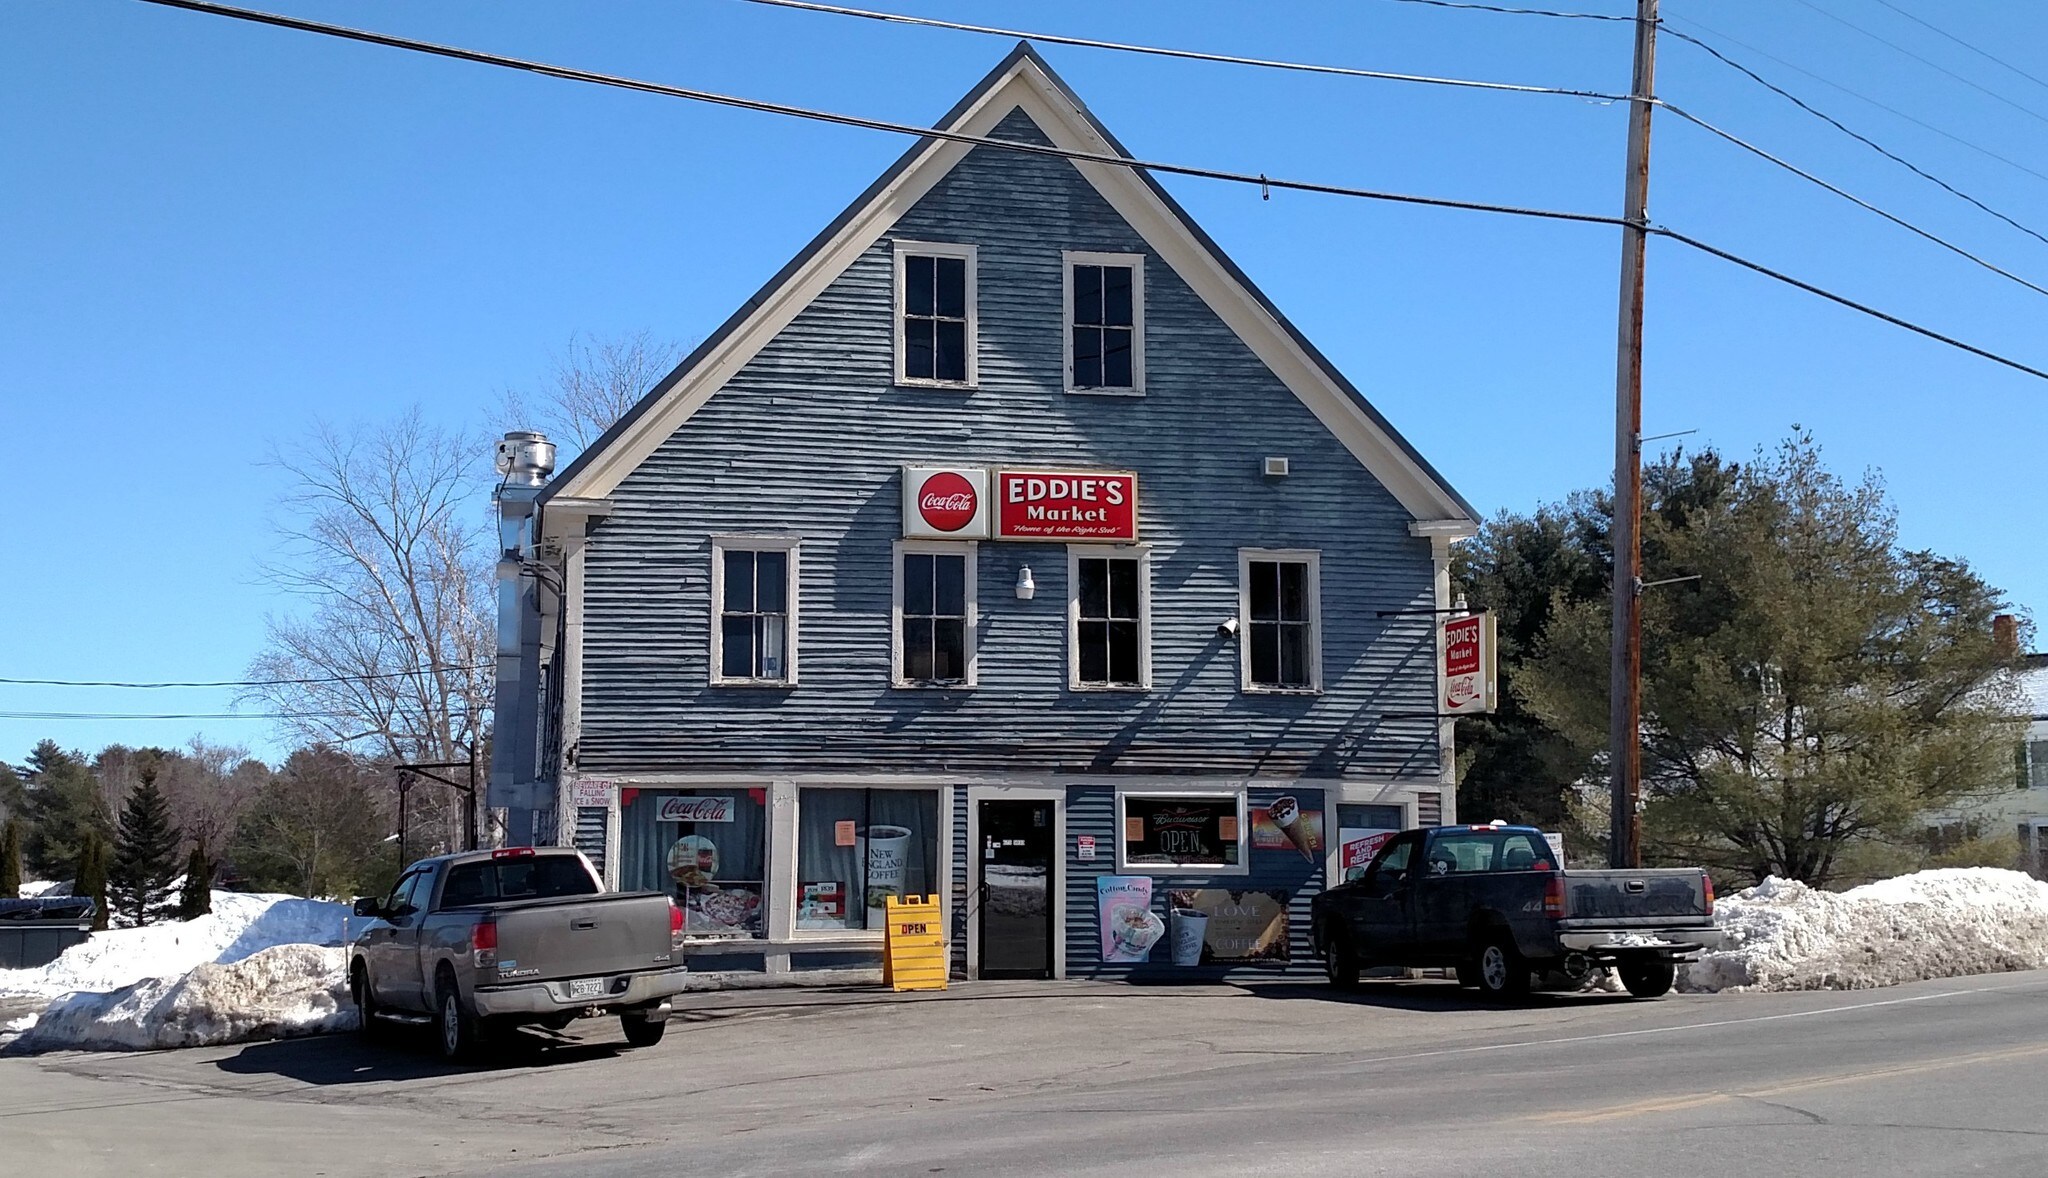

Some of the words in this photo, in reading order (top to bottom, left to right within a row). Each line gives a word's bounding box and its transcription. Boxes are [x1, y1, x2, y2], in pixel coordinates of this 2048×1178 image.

[1008, 478, 1124, 506] EDDIE'S
[1027, 506, 1108, 522] Market
[1043, 526, 1055, 535] of
[1072, 526, 1097, 535] Right
[1446, 625, 1477, 649] EDDIE'S
[580, 789, 606, 797] FALLING
[591, 797, 611, 806] SNOW
[1161, 830, 1200, 853] OPEN
[1350, 836, 1384, 850] REFRESH
[870, 848, 893, 859] NEW
[1356, 845, 1372, 855] AND
[1214, 904, 1261, 917] LOVE
[901, 923, 927, 934] OPEN
[1215, 938, 1262, 950] COFFEE
[499, 968, 540, 979] TUNDRA
